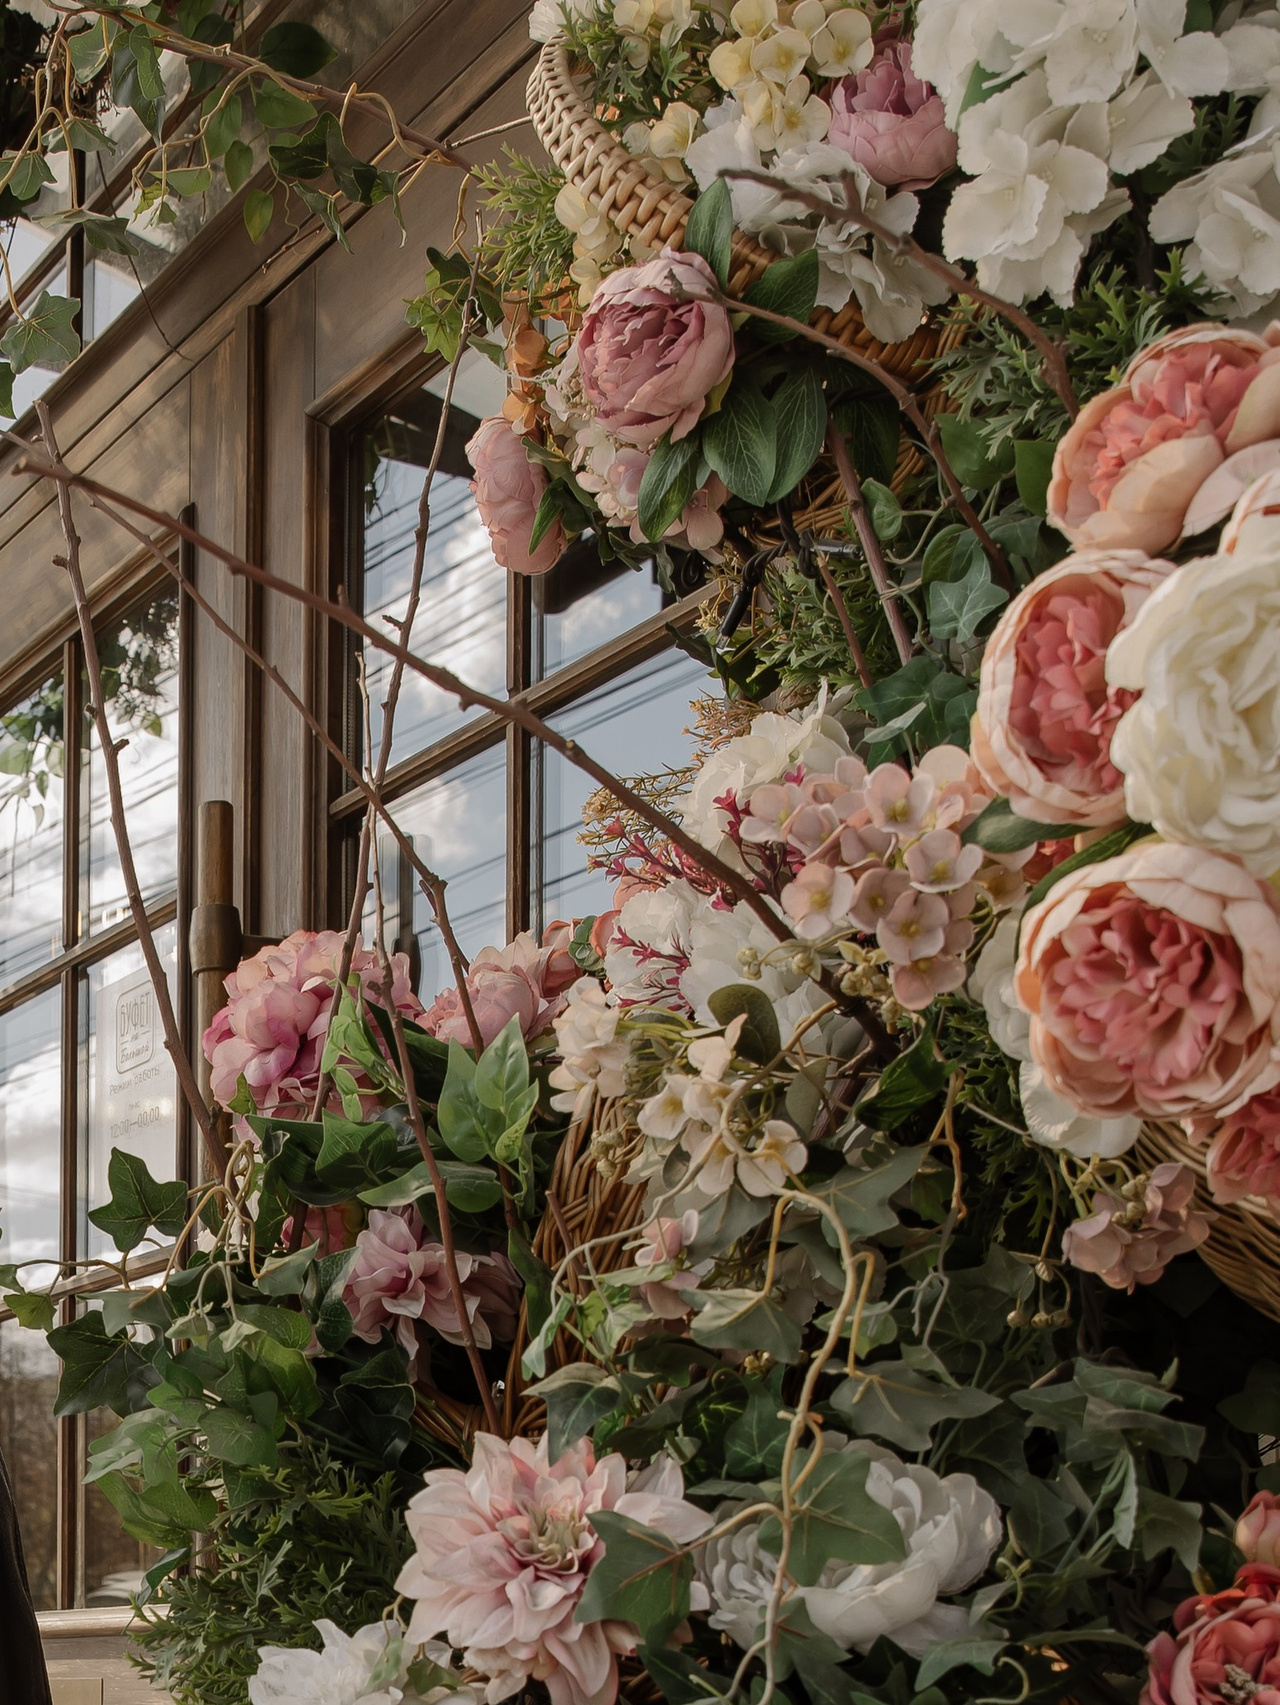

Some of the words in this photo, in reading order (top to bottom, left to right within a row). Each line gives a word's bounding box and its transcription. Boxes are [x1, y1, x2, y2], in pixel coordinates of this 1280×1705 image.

[120, 991, 150, 1037] БУФЕТ
[109, 1079, 132, 1096] Режим
[134, 1066, 160, 1087] работы
